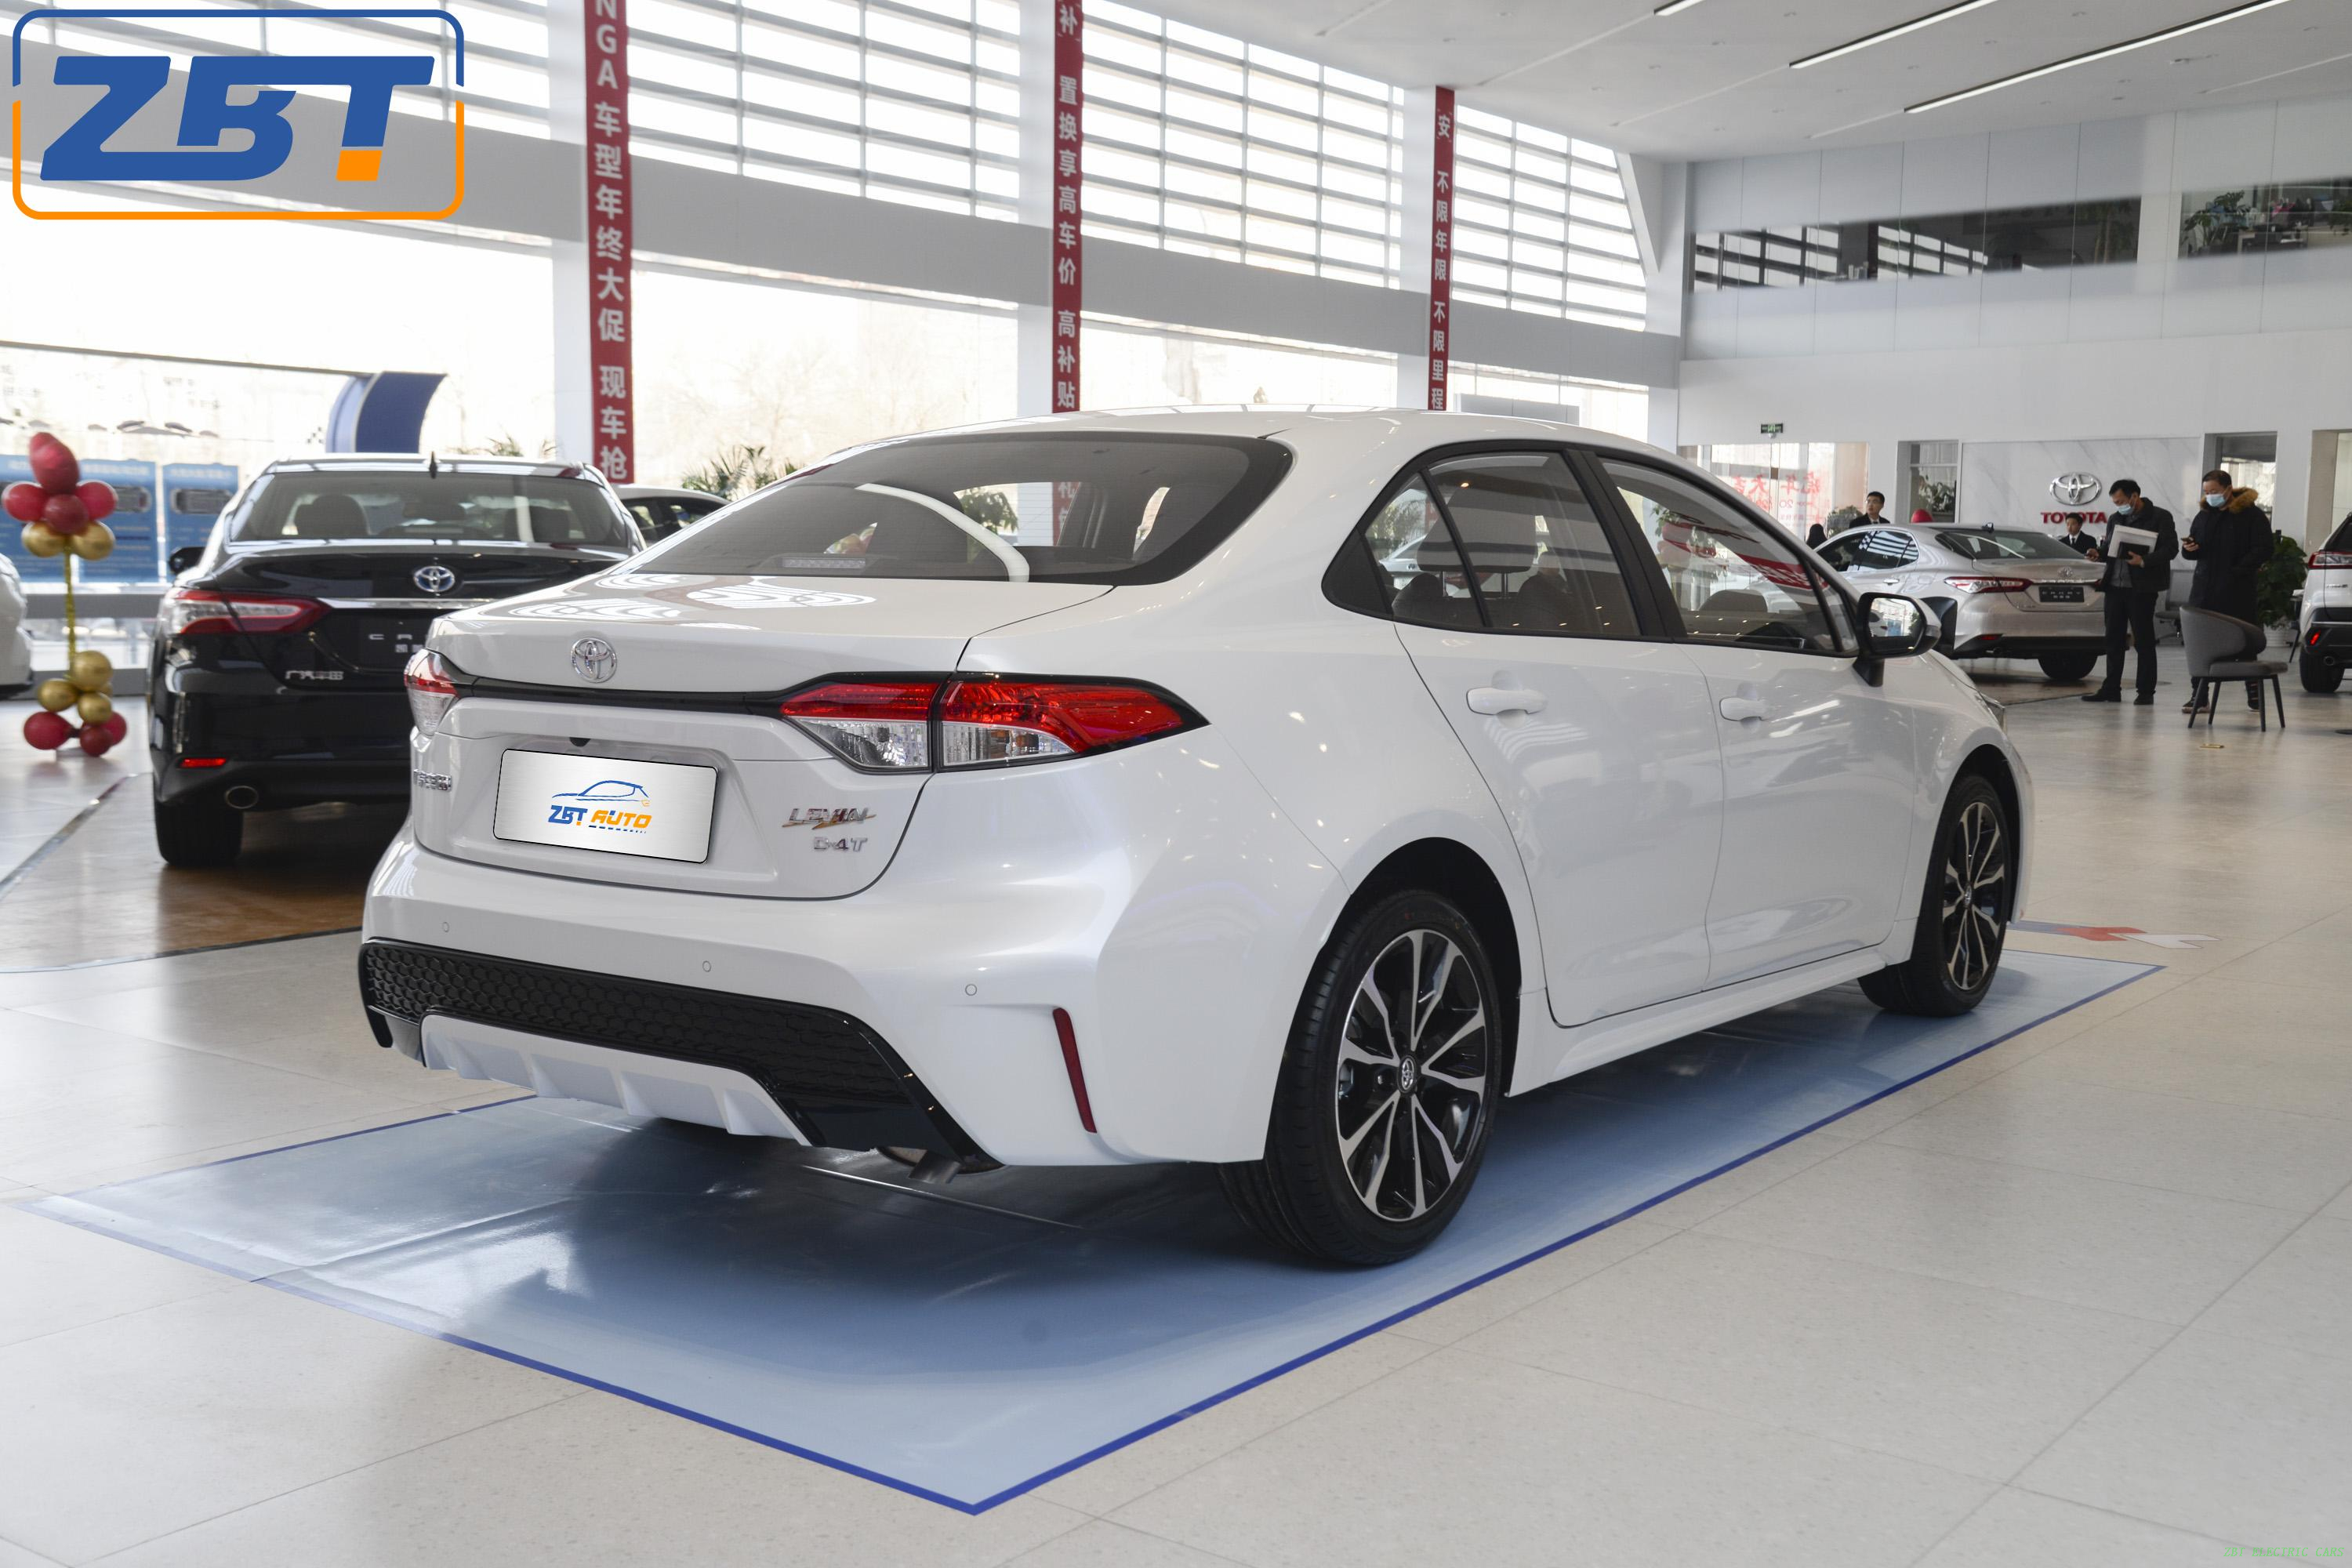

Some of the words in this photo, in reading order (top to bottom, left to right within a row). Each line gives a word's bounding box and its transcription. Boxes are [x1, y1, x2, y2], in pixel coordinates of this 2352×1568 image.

[1058, 75, 1078, 285] 置换享高车价
[1435, 170, 1449, 281] 不限年限
[1057, 310, 1076, 408] 高补贴
[1431, 301, 1446, 410] 不限里程
[600, 365, 627, 480] 现车抢
